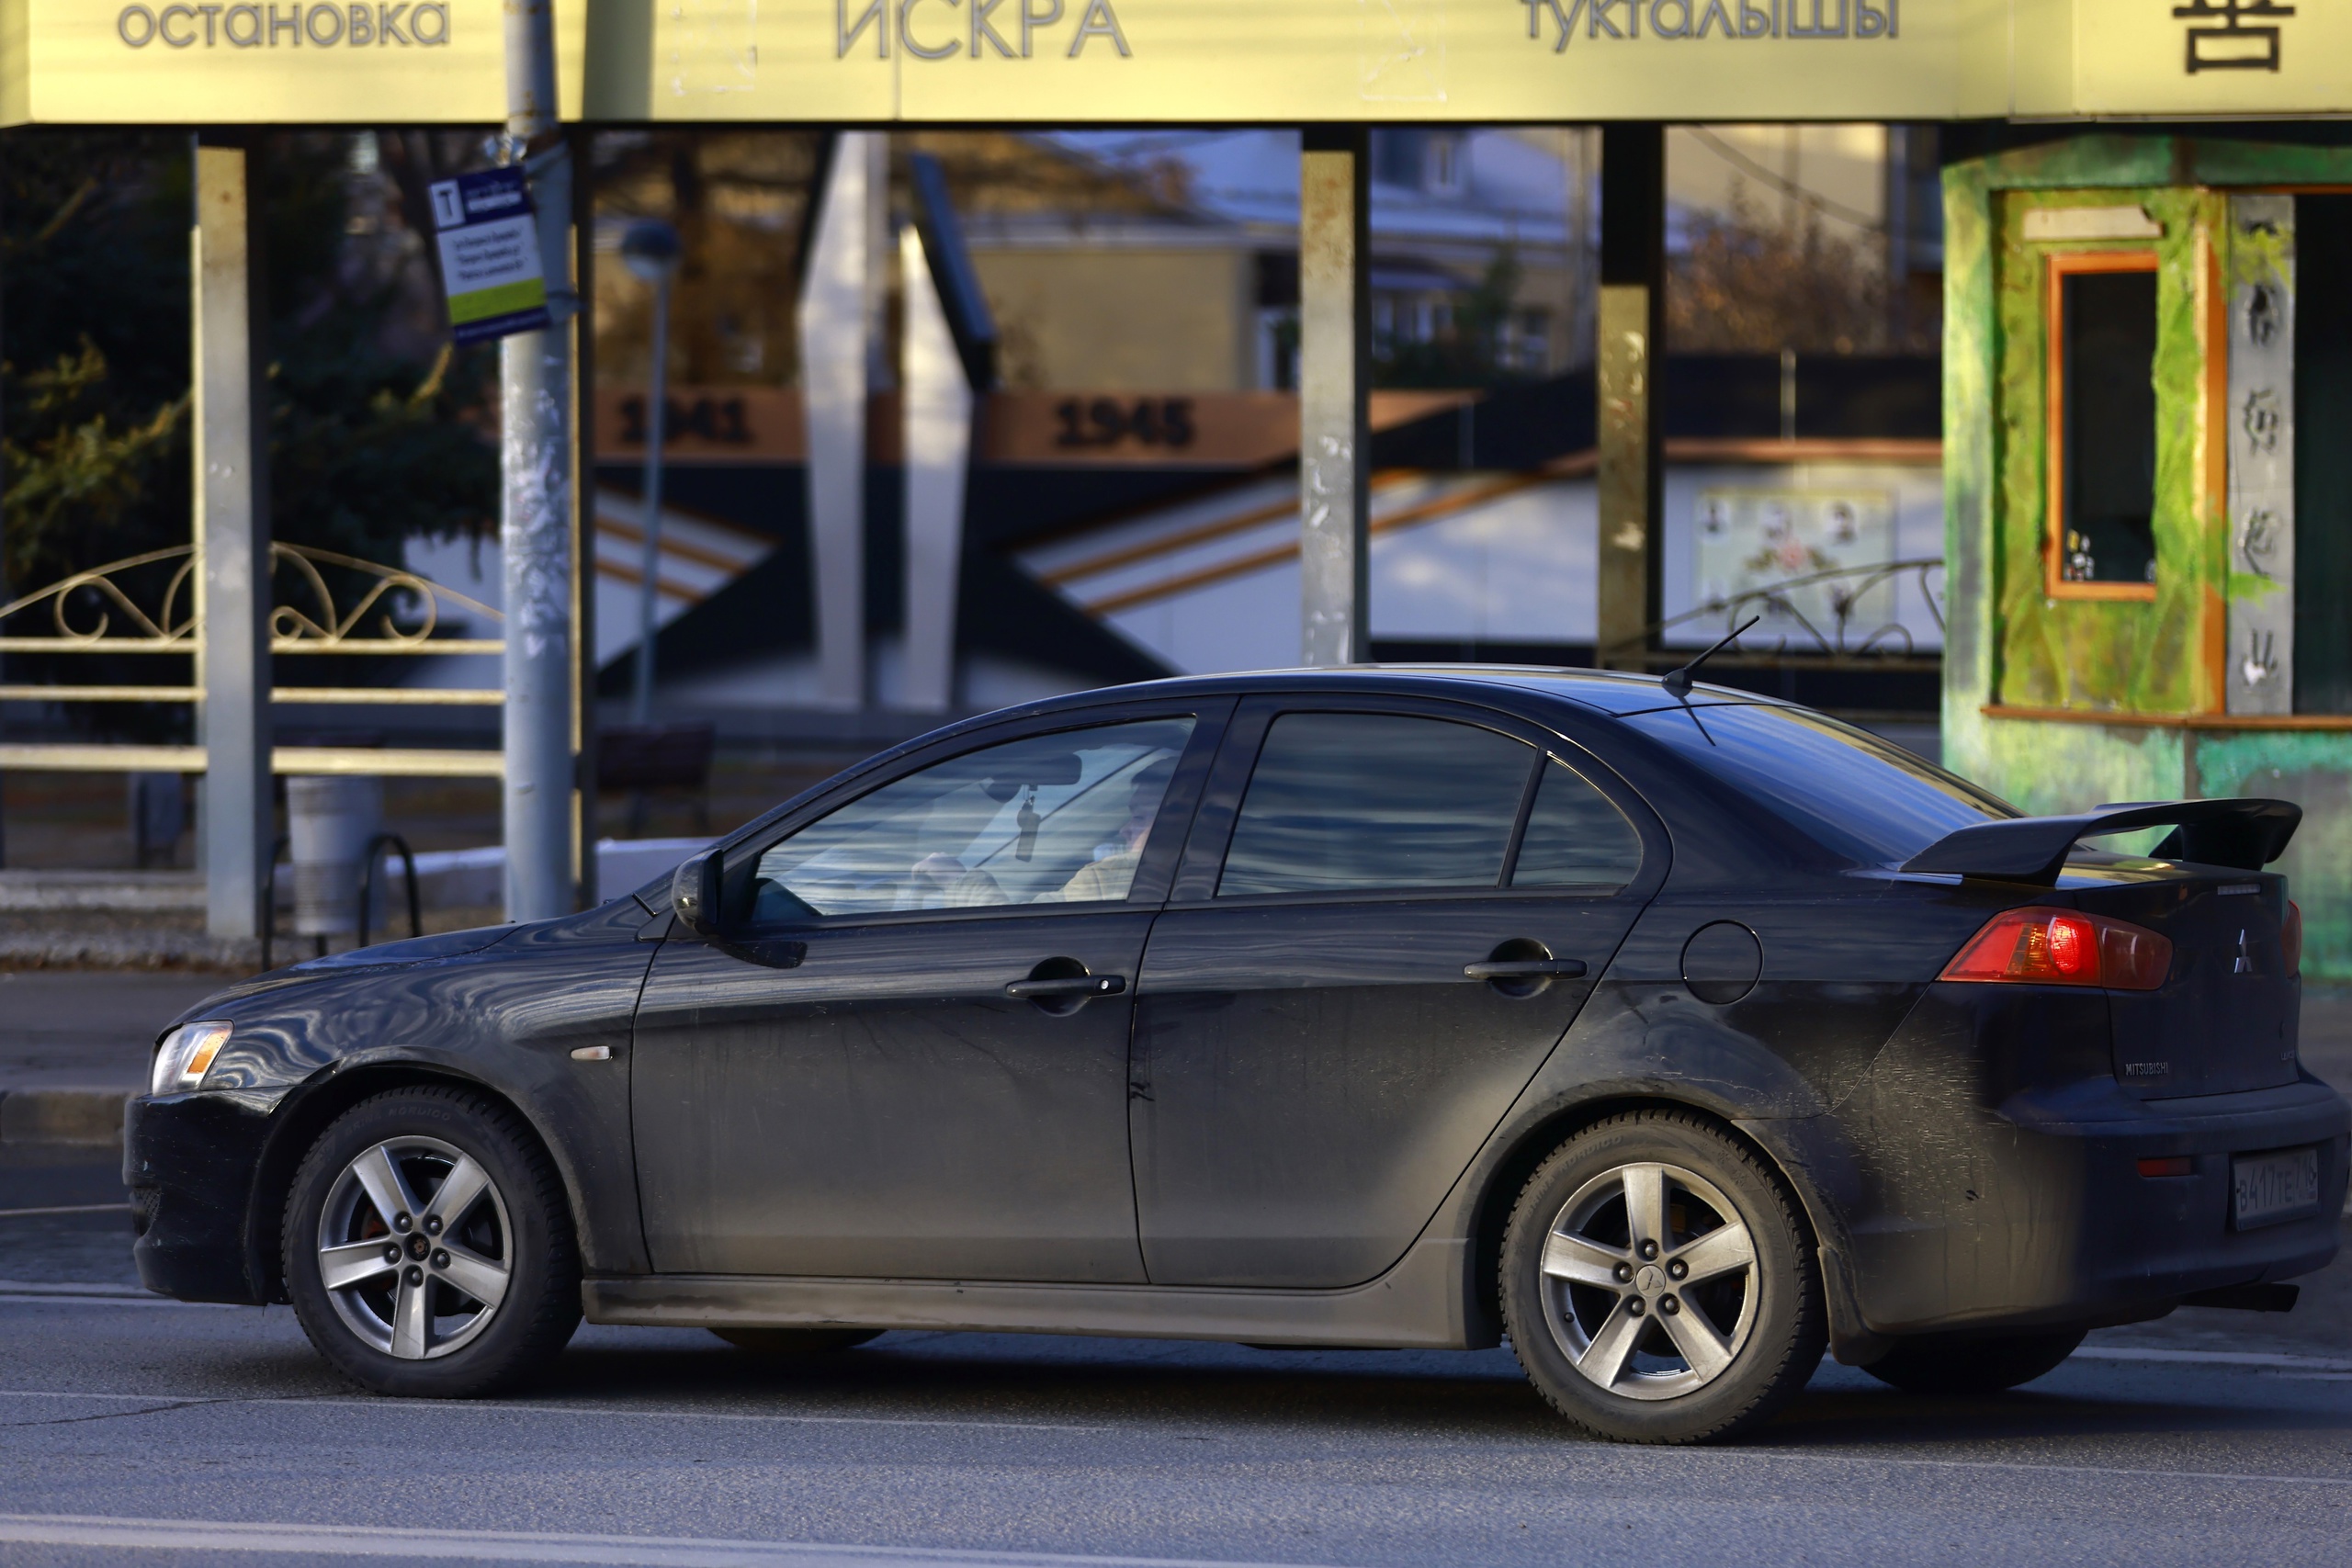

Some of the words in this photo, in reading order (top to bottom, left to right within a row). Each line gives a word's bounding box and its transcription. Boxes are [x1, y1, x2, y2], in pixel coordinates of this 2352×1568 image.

[837, 0, 1133, 59] ИСКРА
[1055, 396, 1199, 447] 1945
[2125, 1062, 2168, 1076] MITSUBISHI
